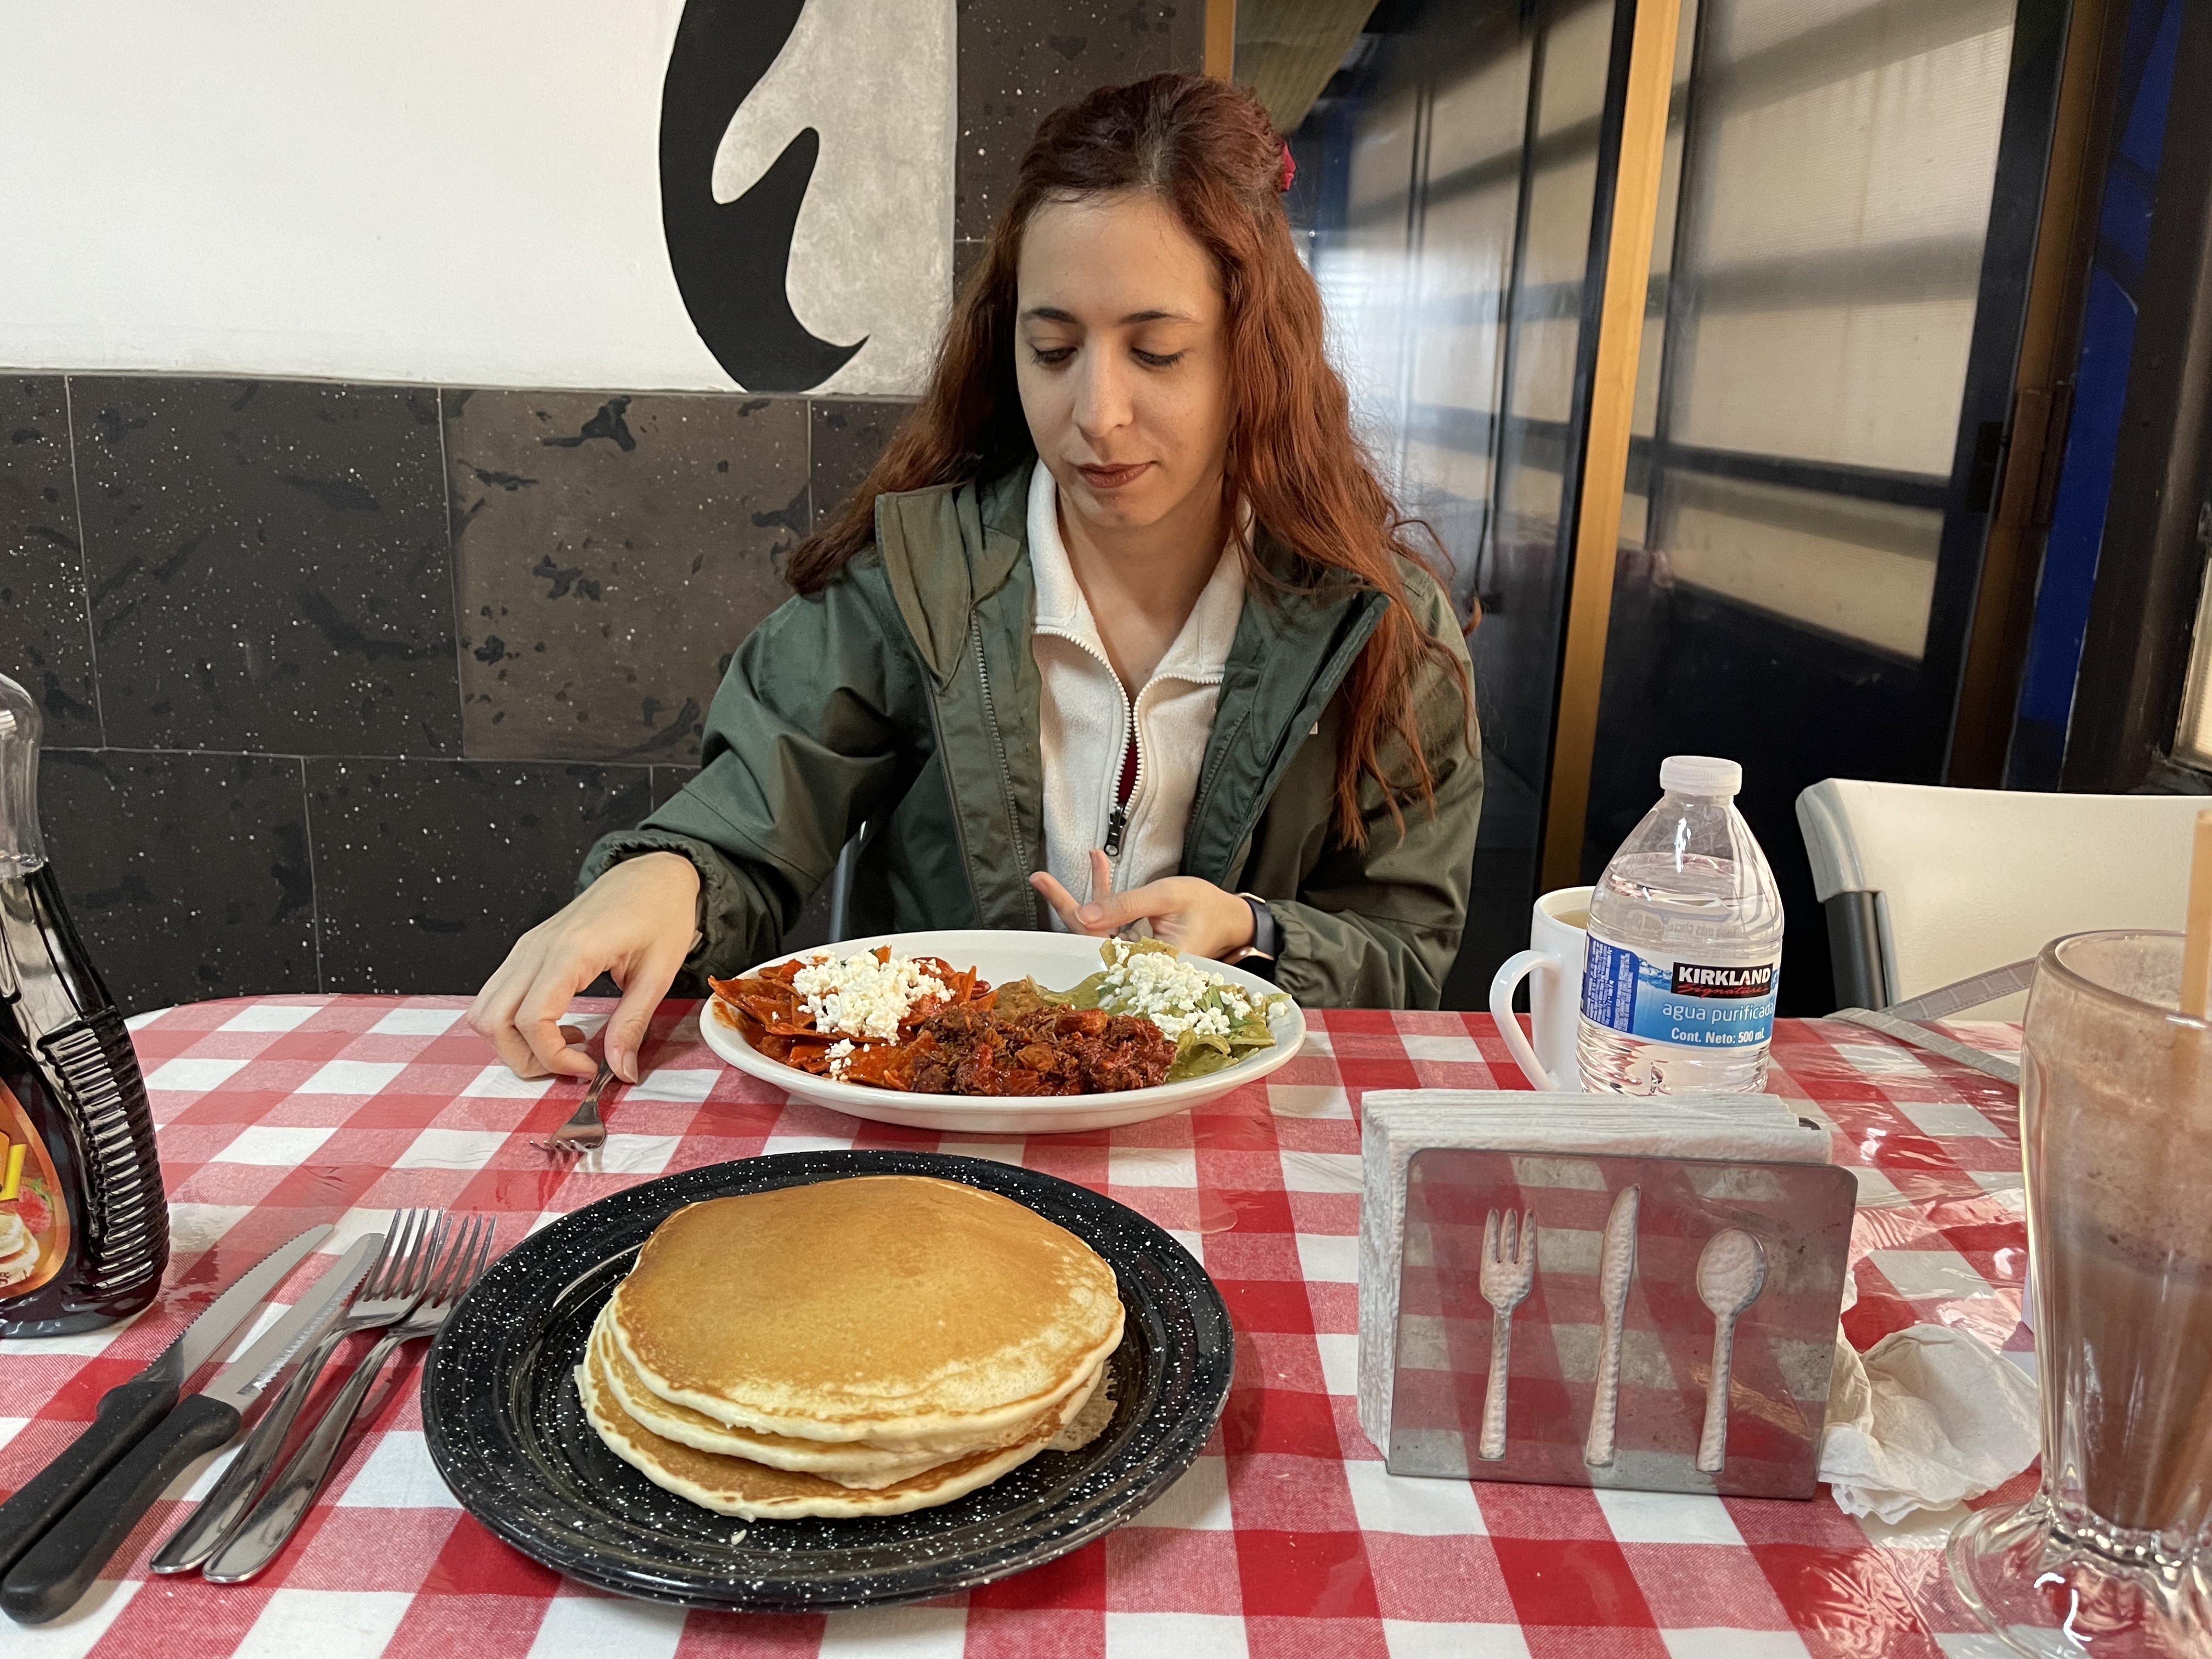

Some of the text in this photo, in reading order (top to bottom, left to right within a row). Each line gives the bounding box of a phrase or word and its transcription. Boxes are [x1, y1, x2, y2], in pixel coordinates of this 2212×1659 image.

[1678, 966, 1771, 986] KIRKLAND
[1677, 983, 1769, 999] Signature
[1663, 1000, 1774, 1025] agua purificada
[1671, 1027, 1702, 1042] Cont.
[1706, 1031, 1736, 1044] Neto:
[1738, 1030, 1753, 1043] 500
